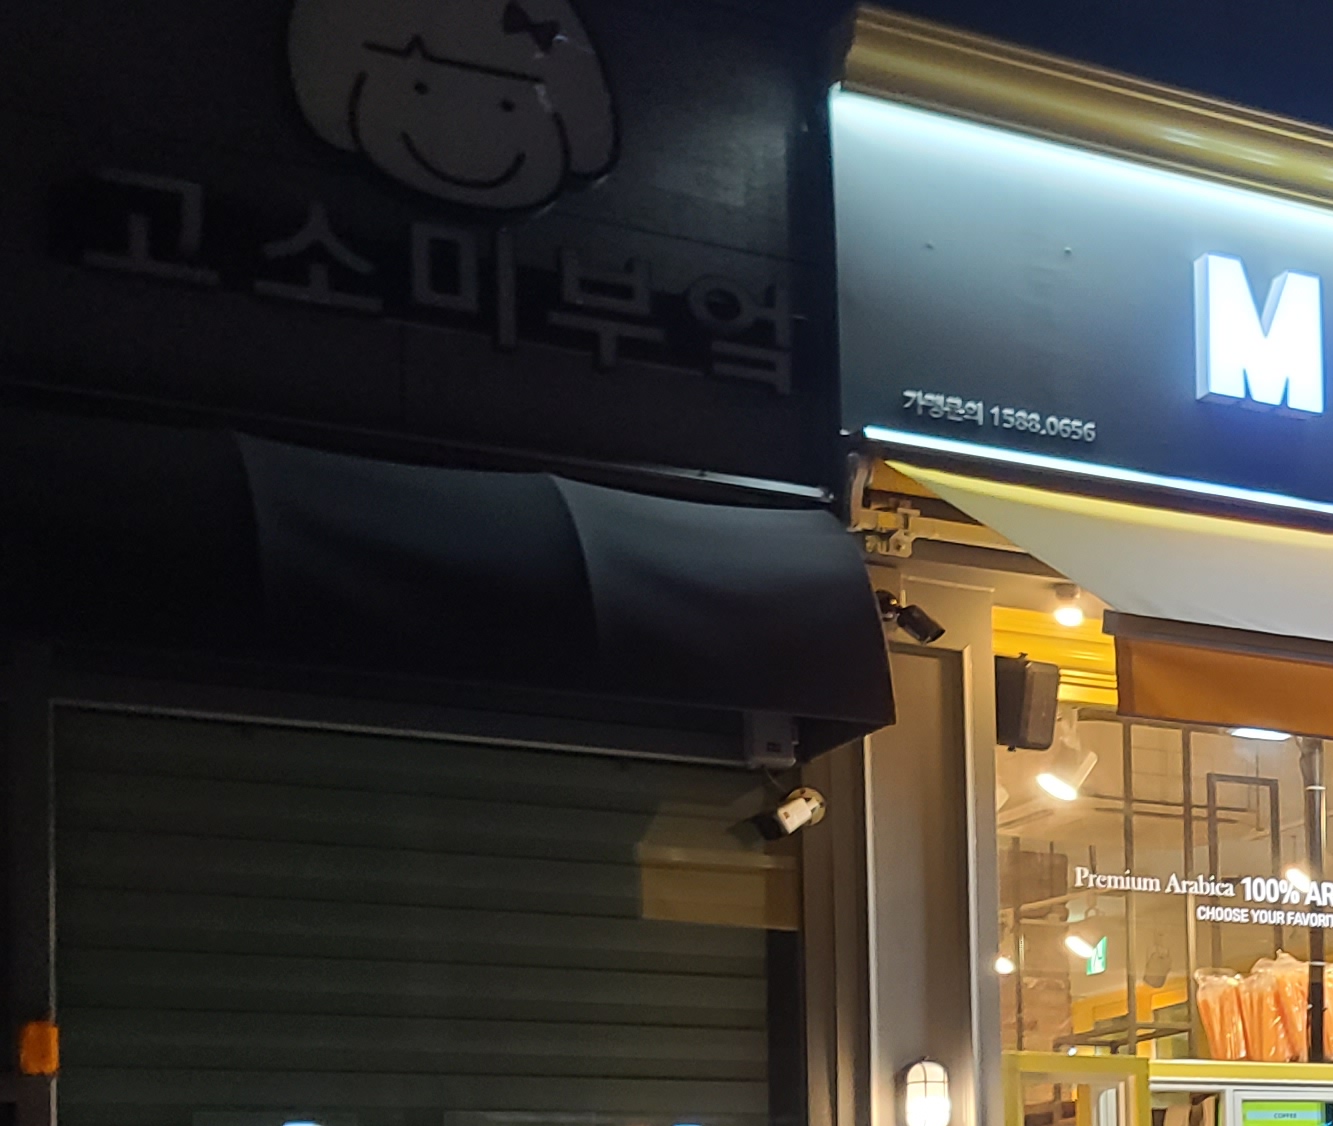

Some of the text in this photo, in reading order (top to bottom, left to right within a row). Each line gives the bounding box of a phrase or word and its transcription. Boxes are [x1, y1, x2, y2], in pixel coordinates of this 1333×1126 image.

[81, 168, 793, 396] 고소미부엌
[903, 389, 1097, 442] 가맹문의 1588.0656
[1074, 866, 1161, 893] Premium
[1165, 872, 1236, 898] Arabica
[1240, 876, 1301, 906] 100%
[1196, 906, 1249, 923] CHOOSE
[1250, 908, 1286, 926] YOUR
